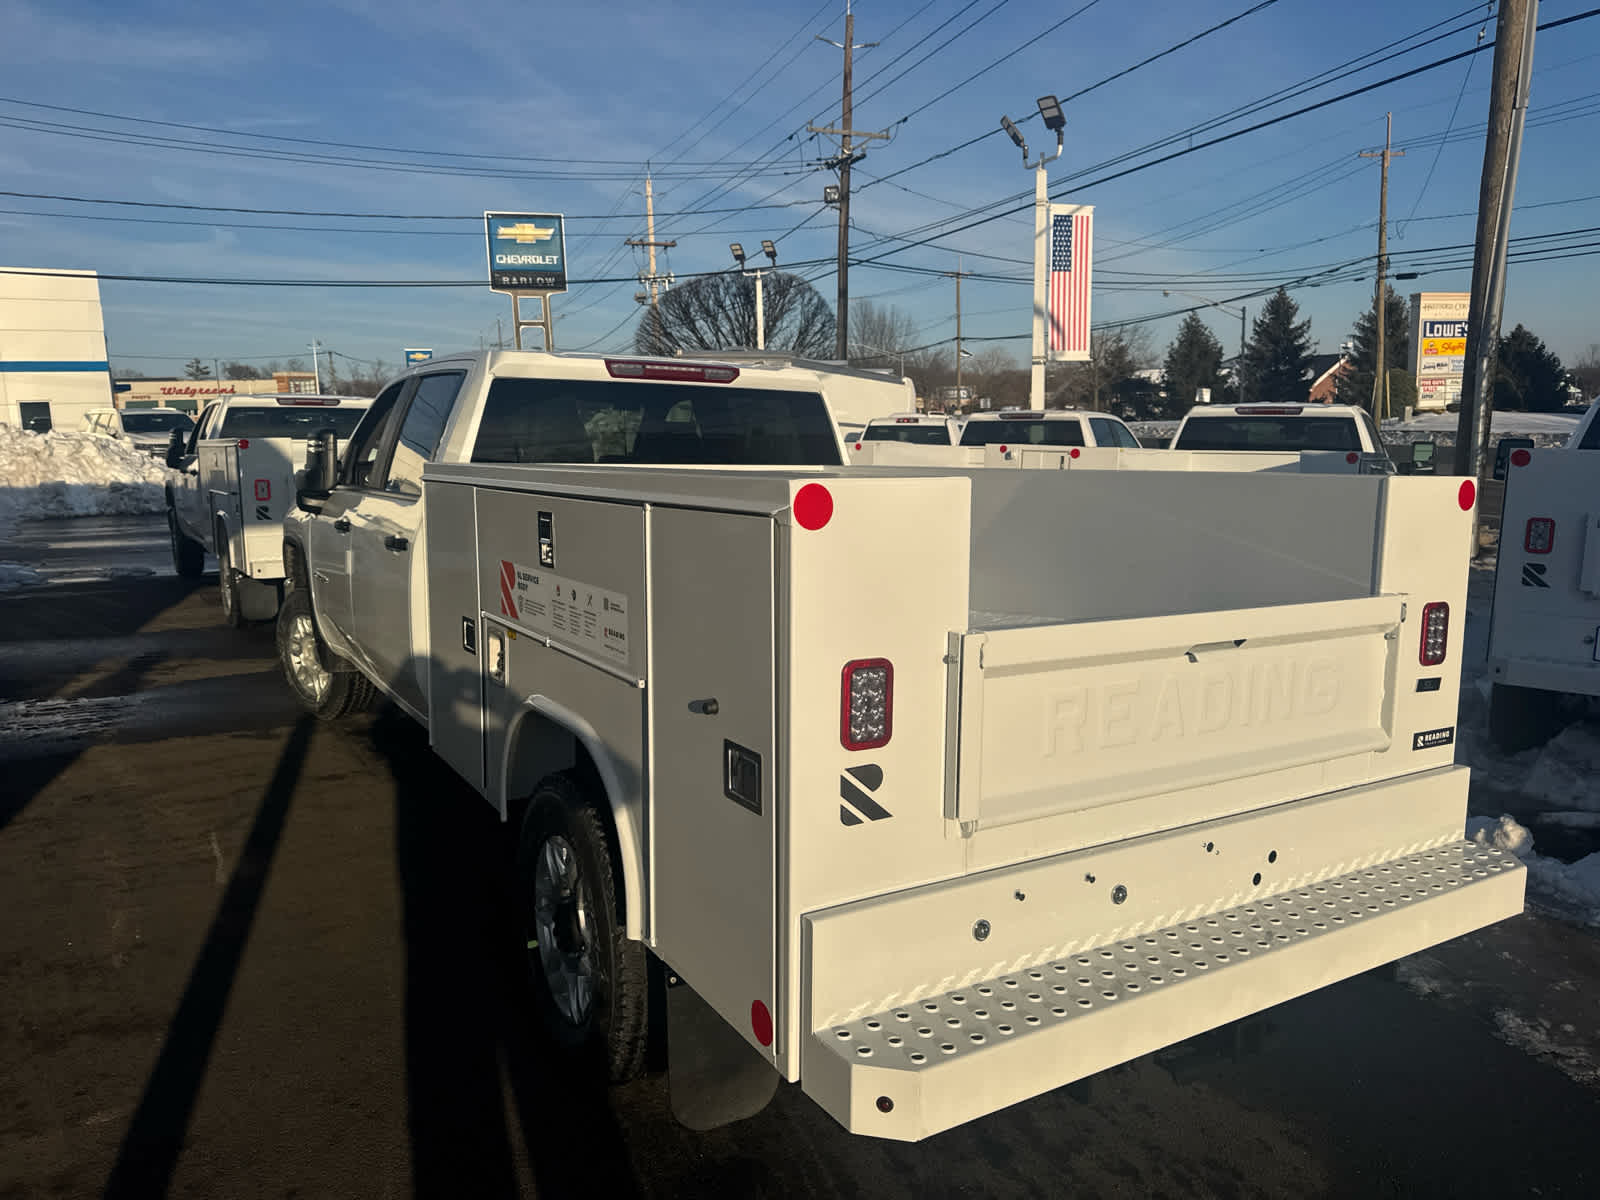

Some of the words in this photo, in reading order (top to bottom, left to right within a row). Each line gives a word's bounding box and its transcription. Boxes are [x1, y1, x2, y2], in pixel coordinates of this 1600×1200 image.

[496, 254, 559, 264] CHEVROLET
[160, 384, 237, 397] Walgreens
[1044, 656, 1344, 758] READING
[1425, 731, 1450, 742] READING
